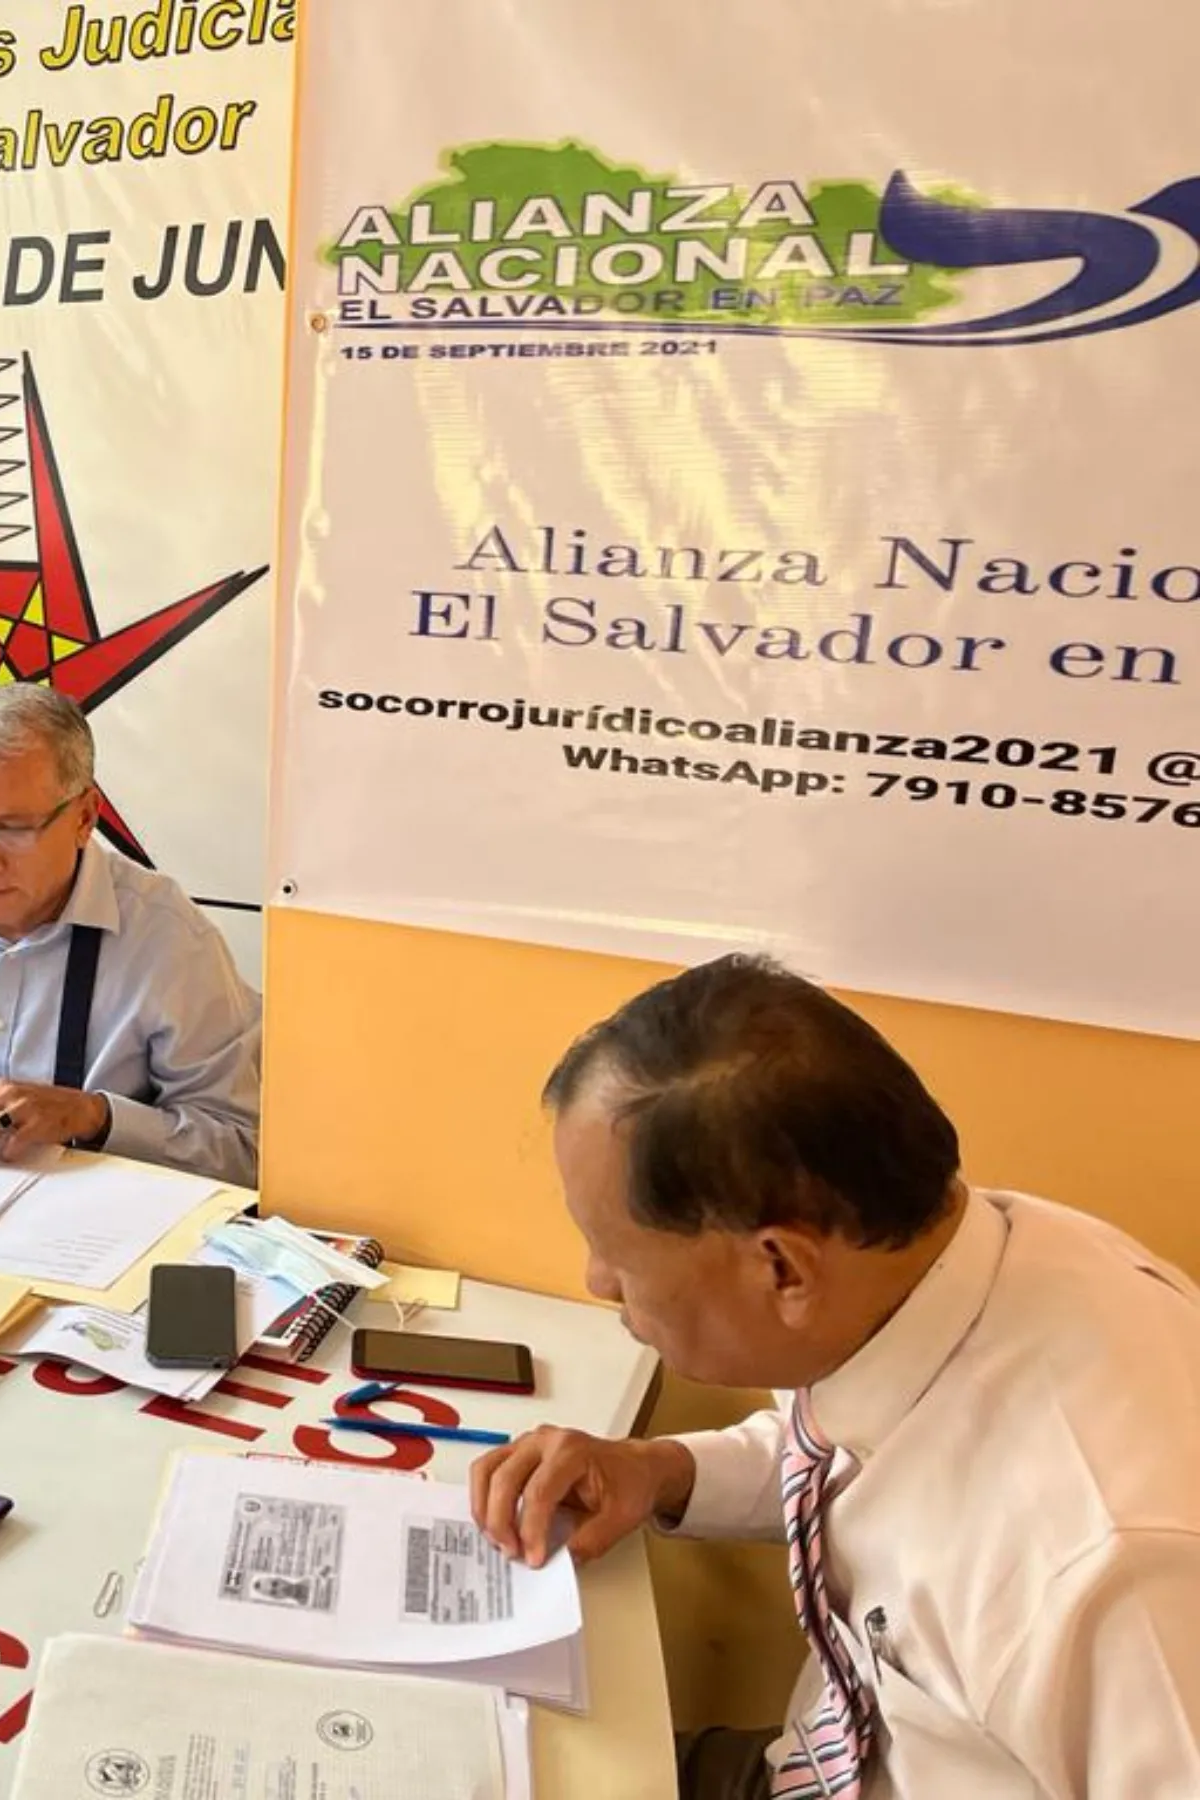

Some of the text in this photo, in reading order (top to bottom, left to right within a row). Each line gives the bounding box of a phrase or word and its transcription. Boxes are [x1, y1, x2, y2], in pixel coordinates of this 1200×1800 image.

[337, 179, 814, 247] ALIANZA
[3, 231, 111, 307] DE
[337, 229, 909, 295] NACIONAL
[339, 281, 905, 321] EL SALVADOR EN PAZ
[341, 338, 719, 361] 15 DE SEPTIEMBRE 2021
[452, 523, 1200, 603] Alianza Nacio
[408, 590, 1181, 684] El Salvador en
[317, 685, 1118, 776] socorrojurídicoalianza2021
[562, 743, 1200, 829] WhatsApp: 7910-8576
